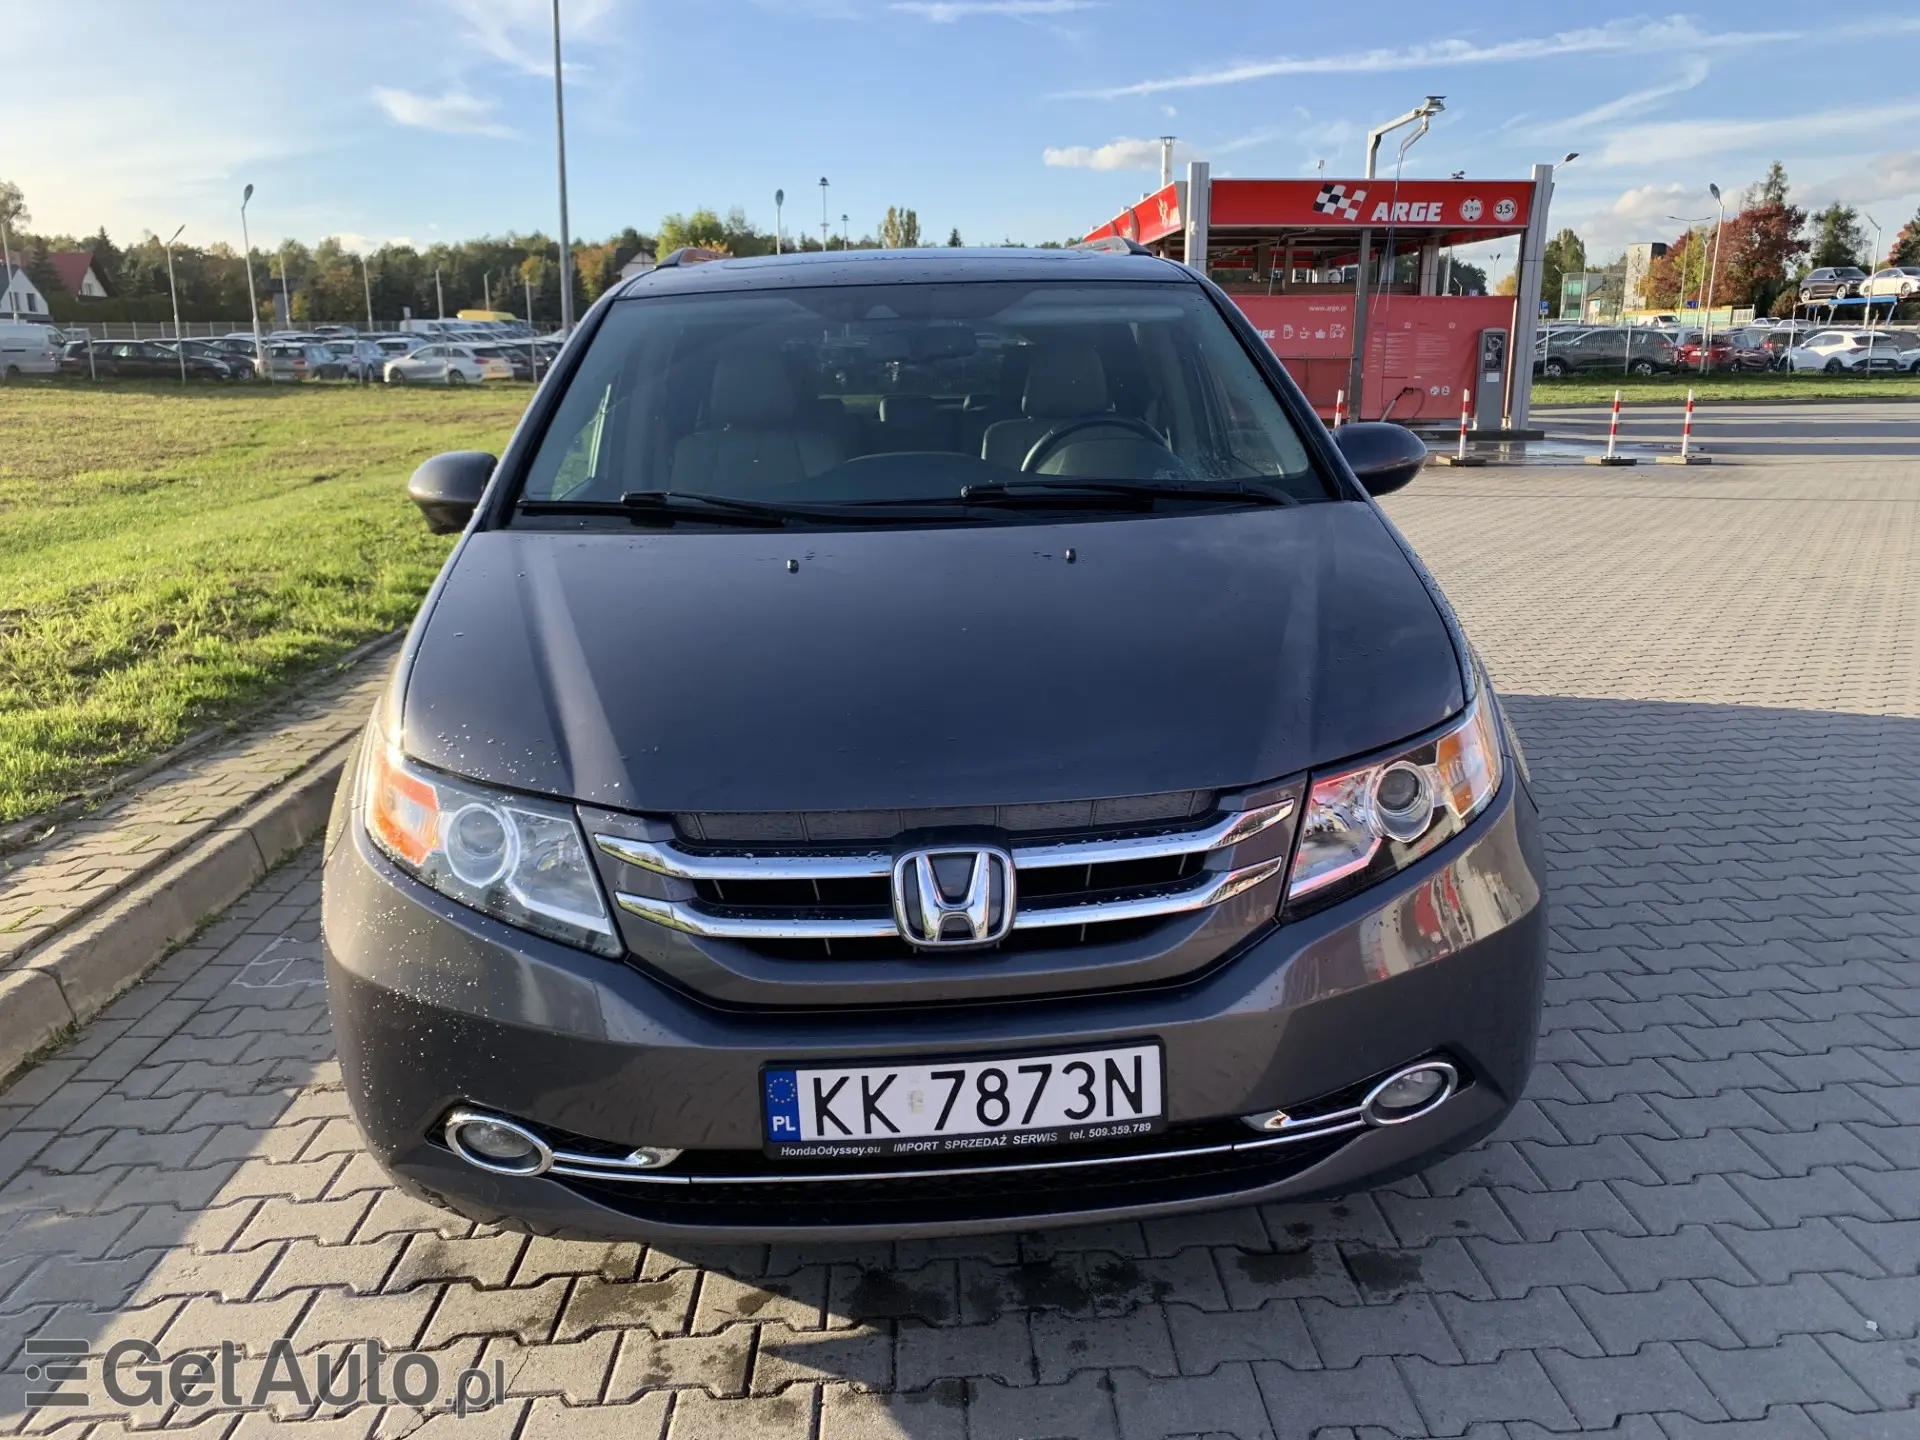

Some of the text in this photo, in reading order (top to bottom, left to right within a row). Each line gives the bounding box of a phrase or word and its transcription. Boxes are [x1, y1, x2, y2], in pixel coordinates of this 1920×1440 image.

[1371, 202, 1444, 222] ARGE
[812, 1055, 1143, 1136] KK 7873N
[772, 1115, 797, 1132] PL
[780, 1122, 1152, 1157] HondaOdyssey.eu IMPORT SPRZEDAŻ SERWIS tel. 509.359.789
